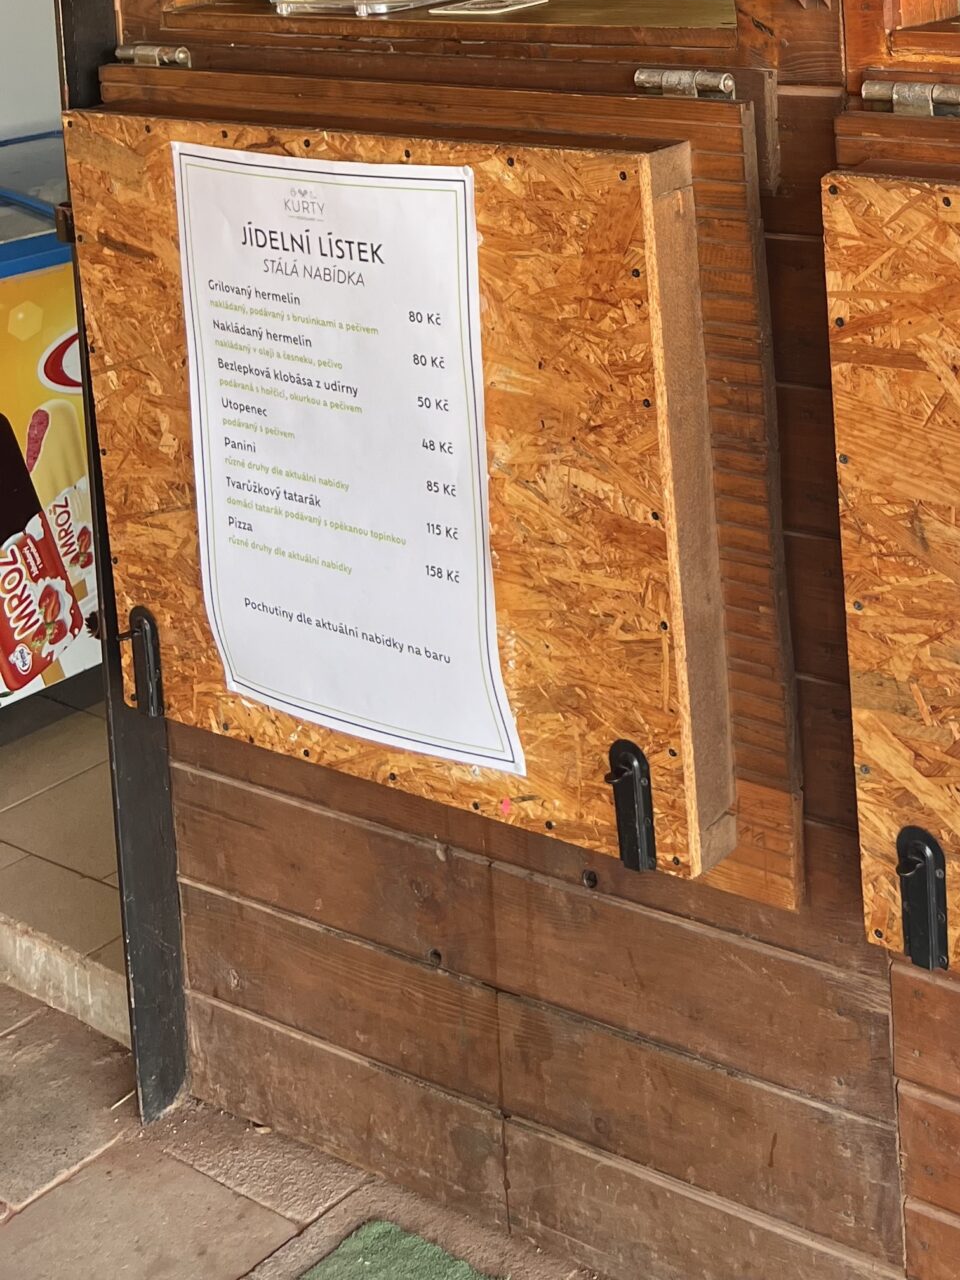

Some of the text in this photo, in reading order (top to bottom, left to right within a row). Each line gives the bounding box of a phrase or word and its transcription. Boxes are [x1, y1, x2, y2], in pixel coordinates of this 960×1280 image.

[284, 198, 325, 216] KURTY
[241, 222, 384, 264] JÍDELNÍ LÍSTEK
[263, 259, 365, 286] STÁLÁ NABÍDKA
[207, 280, 252, 300] Grilovaný
[408, 311, 441, 326] 80 Kč
[212, 320, 263, 341] Nakládaný
[412, 354, 445, 369] 80 Kč
[217, 358, 271, 379] Bezlepková
[273, 370, 313, 387] klobása
[221, 398, 267, 417] Utopenec
[417, 396, 449, 412] 50 Kč
[223, 437, 256, 453] Panini
[421, 439, 453, 455] 48 Kč
[225, 476, 321, 507] Tvarůžkový tatarák
[426, 481, 456, 497] 85 Kč
[227, 516, 253, 532] Pizza
[426, 523, 458, 540] 115 Kč
[425, 565, 459, 583] 158 Kč
[244, 598, 293, 622] Pochutiny
[295, 612, 312, 625] dle
[407, 645, 422, 656] na
[423, 647, 451, 664] baru
